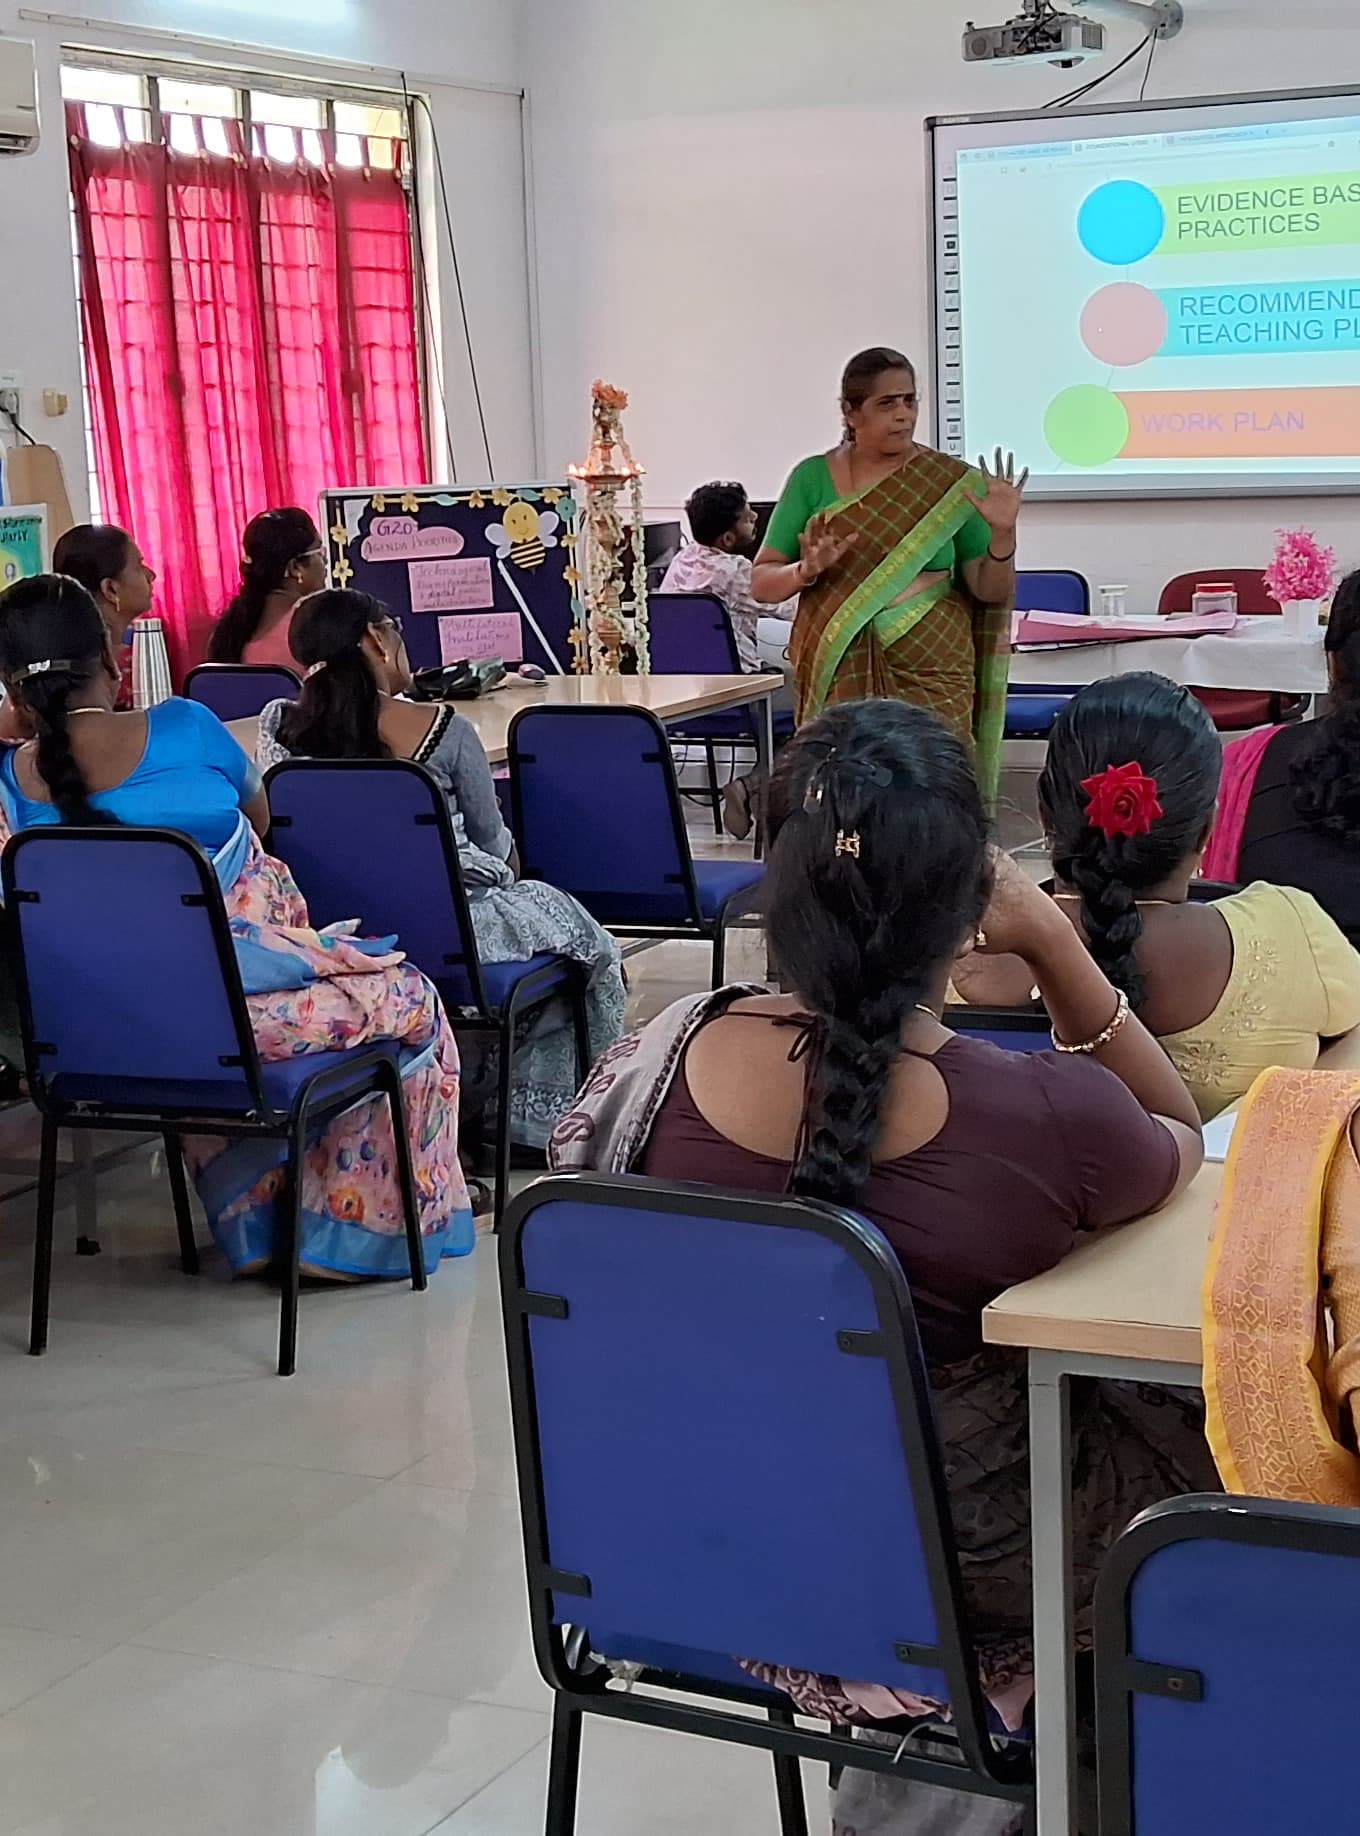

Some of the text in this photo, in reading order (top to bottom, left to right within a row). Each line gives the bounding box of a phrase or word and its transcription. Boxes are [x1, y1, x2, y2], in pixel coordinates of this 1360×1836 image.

[1177, 187, 1305, 215] EVIDENCE
[1178, 212, 1320, 240] PRACTICES
[1180, 317, 1324, 345] TEACHING
[1142, 410, 1305, 434] WORK PLAN
[376, 519, 412, 536] G20
